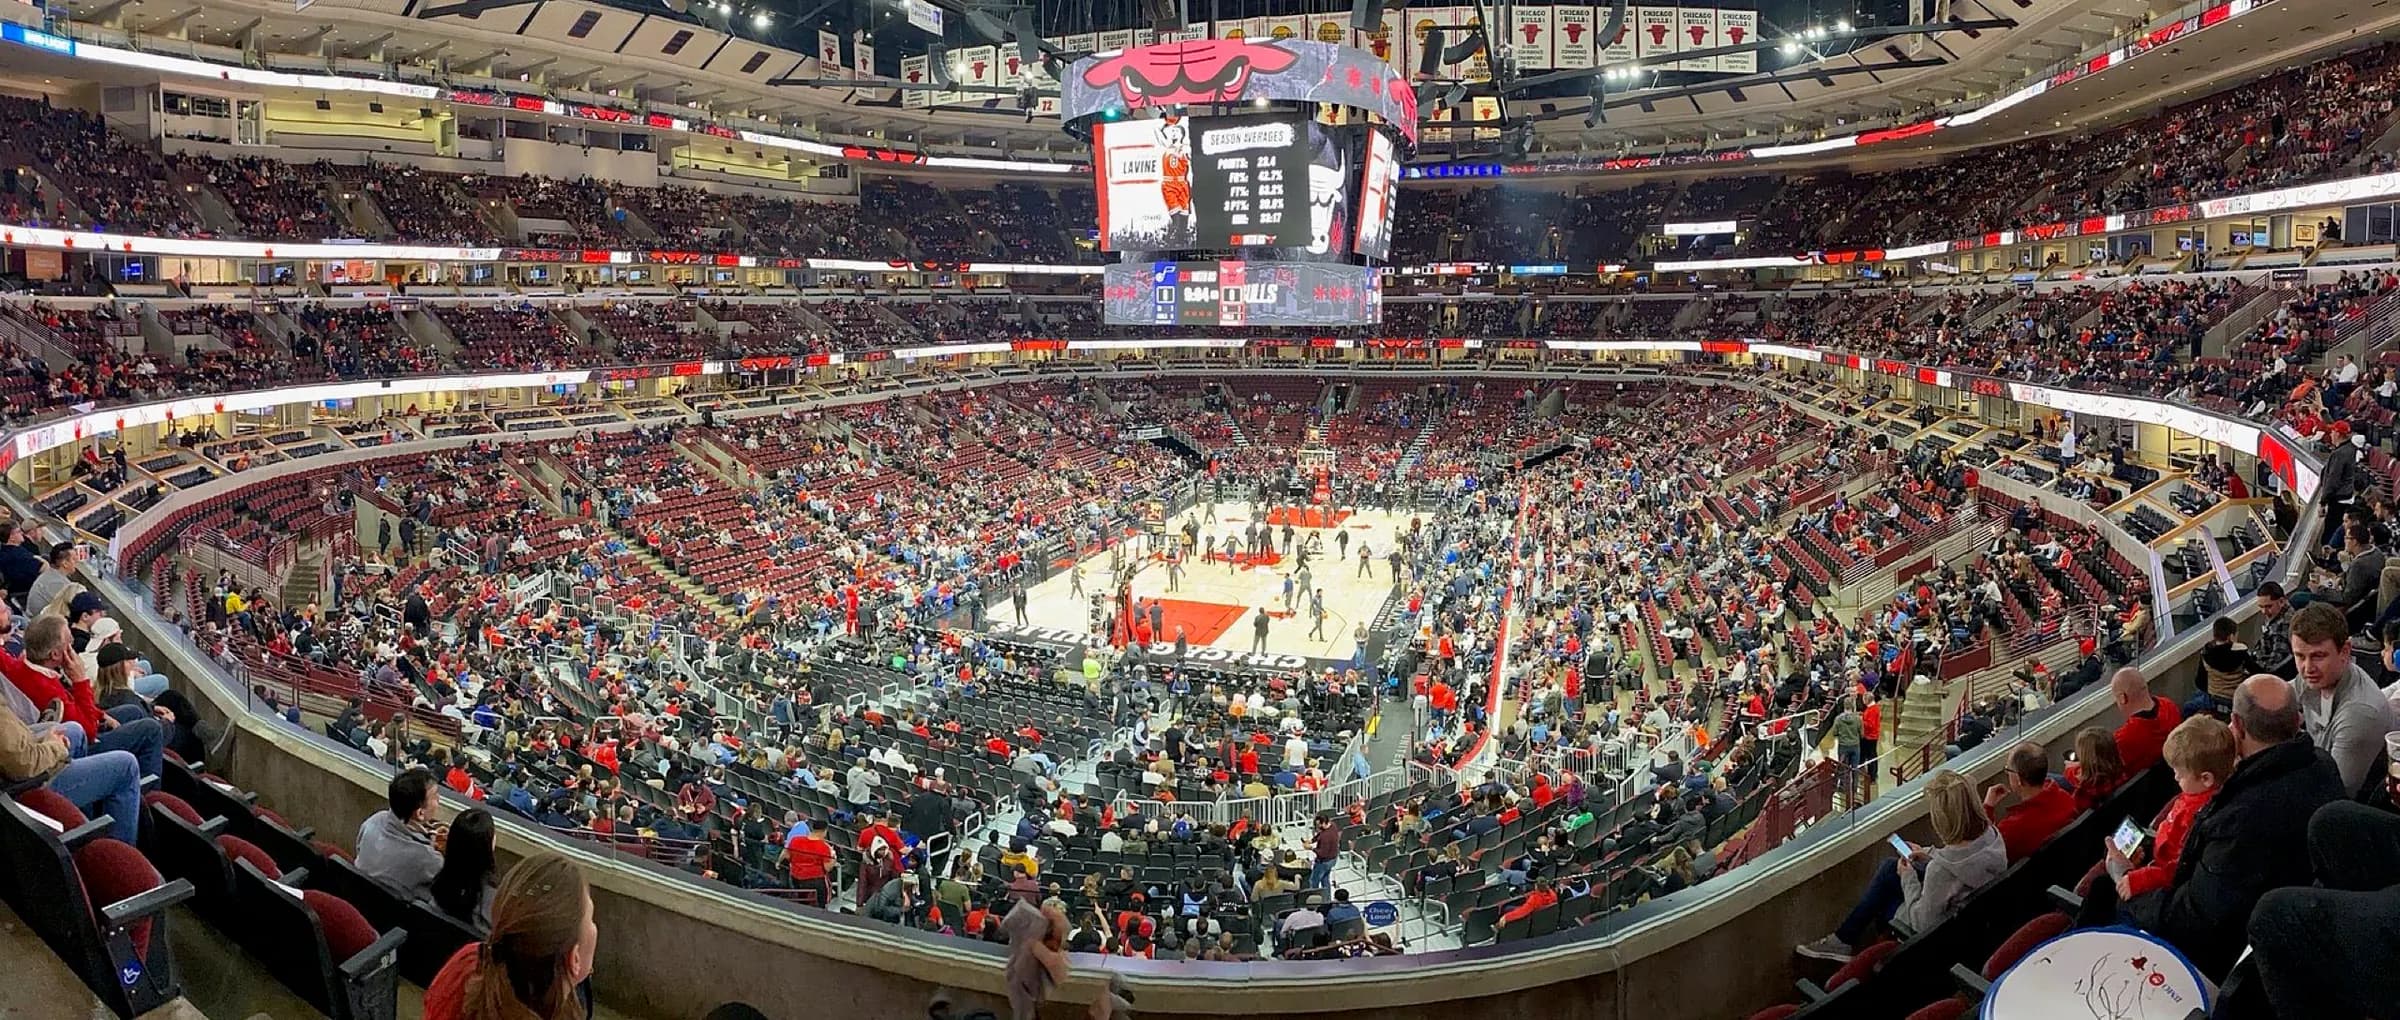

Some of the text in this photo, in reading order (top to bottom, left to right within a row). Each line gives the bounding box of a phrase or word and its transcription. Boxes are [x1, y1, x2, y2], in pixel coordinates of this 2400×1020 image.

[1042, 100, 1053, 111] 72
[1210, 130, 1284, 146] SEASON AVERAGES
[1123, 160, 1157, 174] LAVINE
[1427, 163, 1502, 179] CENTER
[1243, 284, 1278, 304] ULLS
